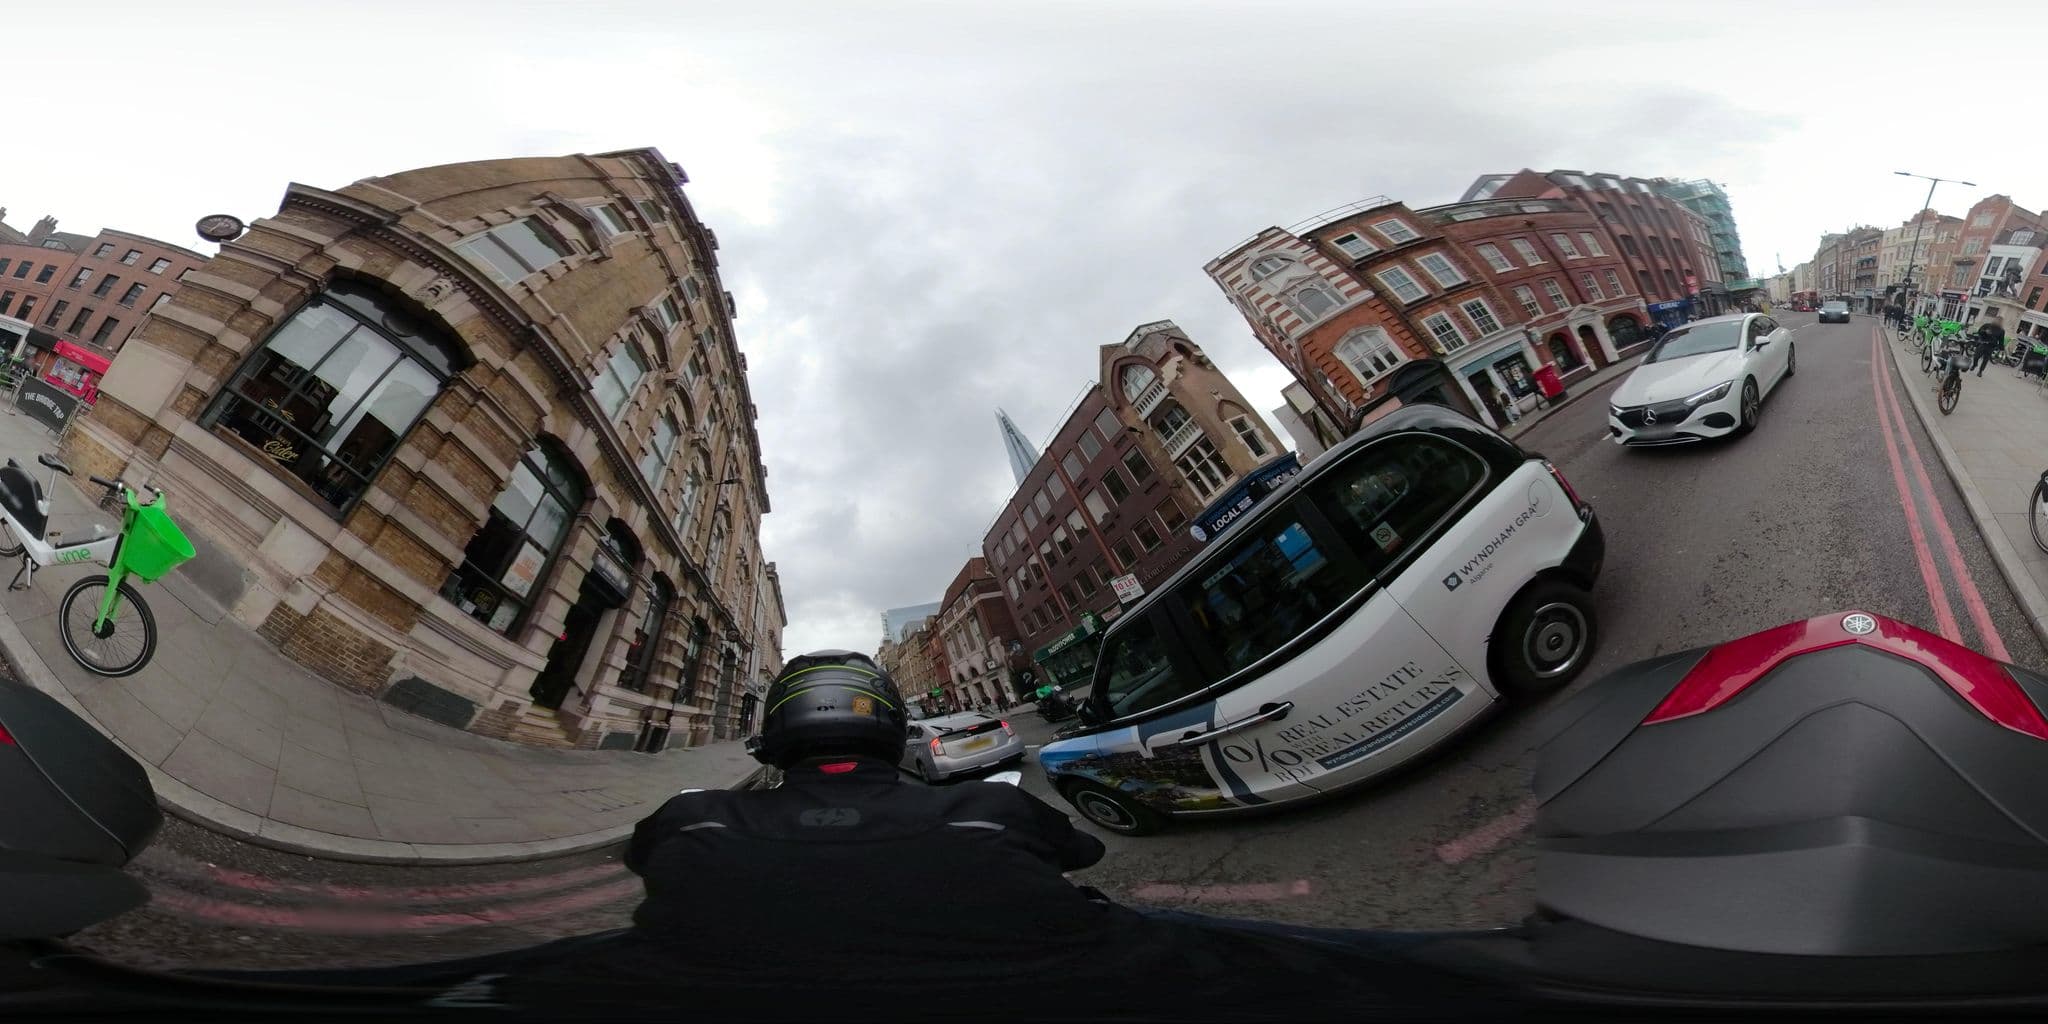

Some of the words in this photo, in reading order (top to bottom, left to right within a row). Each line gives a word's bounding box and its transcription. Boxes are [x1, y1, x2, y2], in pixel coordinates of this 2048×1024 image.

[25, 392, 36, 400] THE
[53, 406, 64, 419] TAP
[264, 439, 299, 461] Cider
[1212, 508, 1240, 532] LOCAL
[1460, 525, 1516, 576] WYNDHAM
[1114, 583, 1124, 591] TO
[1125, 578, 1137, 588] LET
[1470, 562, 1494, 585] Algarve
[1279, 713, 1341, 743] REAL
[1335, 660, 1423, 718] ESTATE
[1300, 732, 1366, 759] REAL
[1360, 665, 1461, 733] RETURNS
